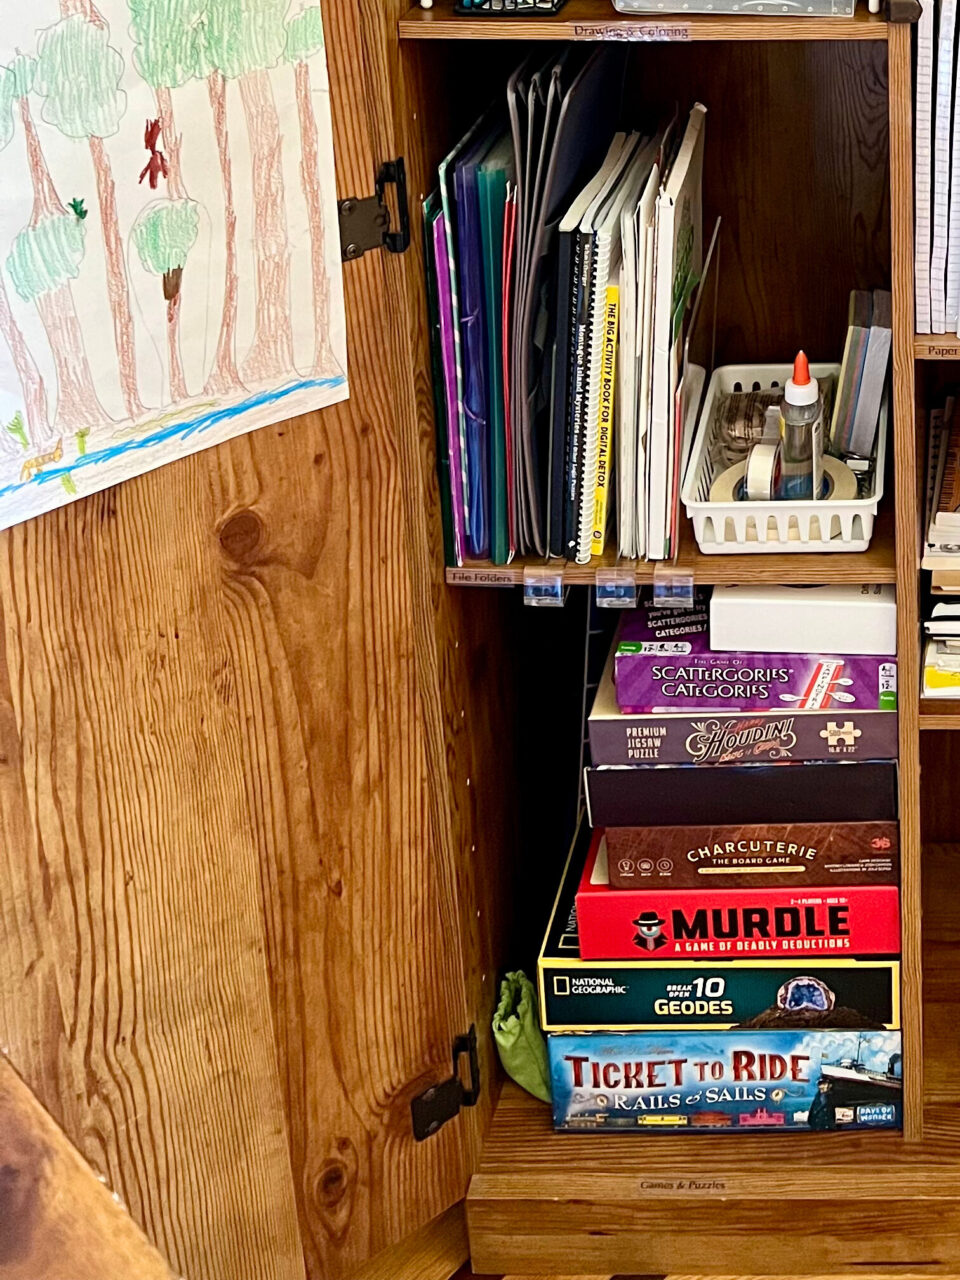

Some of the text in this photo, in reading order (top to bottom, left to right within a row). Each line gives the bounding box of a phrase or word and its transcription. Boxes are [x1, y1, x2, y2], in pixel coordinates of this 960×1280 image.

[626, 26, 634, 37] &
[639, 25, 688, 39] Coloring
[576, 324, 586, 365] Montague
[928, 346, 958, 357] Paper
[575, 366, 584, 392] Island
[597, 303, 616, 488] THE BIG ACTIVITY BOOK FOR DIGITAL DETOX
[573, 393, 583, 434] Mysteries
[452, 572, 512, 583] File Folders
[652, 666, 790, 682] SCATTERGORIES
[661, 683, 769, 699] CATEGORIES
[626, 727, 667, 737] PREMIUM
[693, 718, 796, 762] HOUDINI
[627, 738, 662, 748] JIGSAW
[628, 749, 659, 759] PUZZLE
[686, 840, 817, 862] CHARCUTERIE
[671, 906, 850, 940] MURDLE
[674, 938, 851, 952] A GAME OF DEADLY DEDUCTIONS
[572, 977, 615, 986] NATIONAL
[572, 985, 627, 994] GEOGRAPHIC
[666, 977, 726, 997] BREAK 10
[654, 999, 733, 1015] GEODES
[563, 1050, 811, 1089] TICKET TO RIDE
[614, 1086, 767, 1111] RAILS & SAILS
[881, 1106, 892, 1114] OF
[640, 1181, 726, 1190] Games & Puzzles
